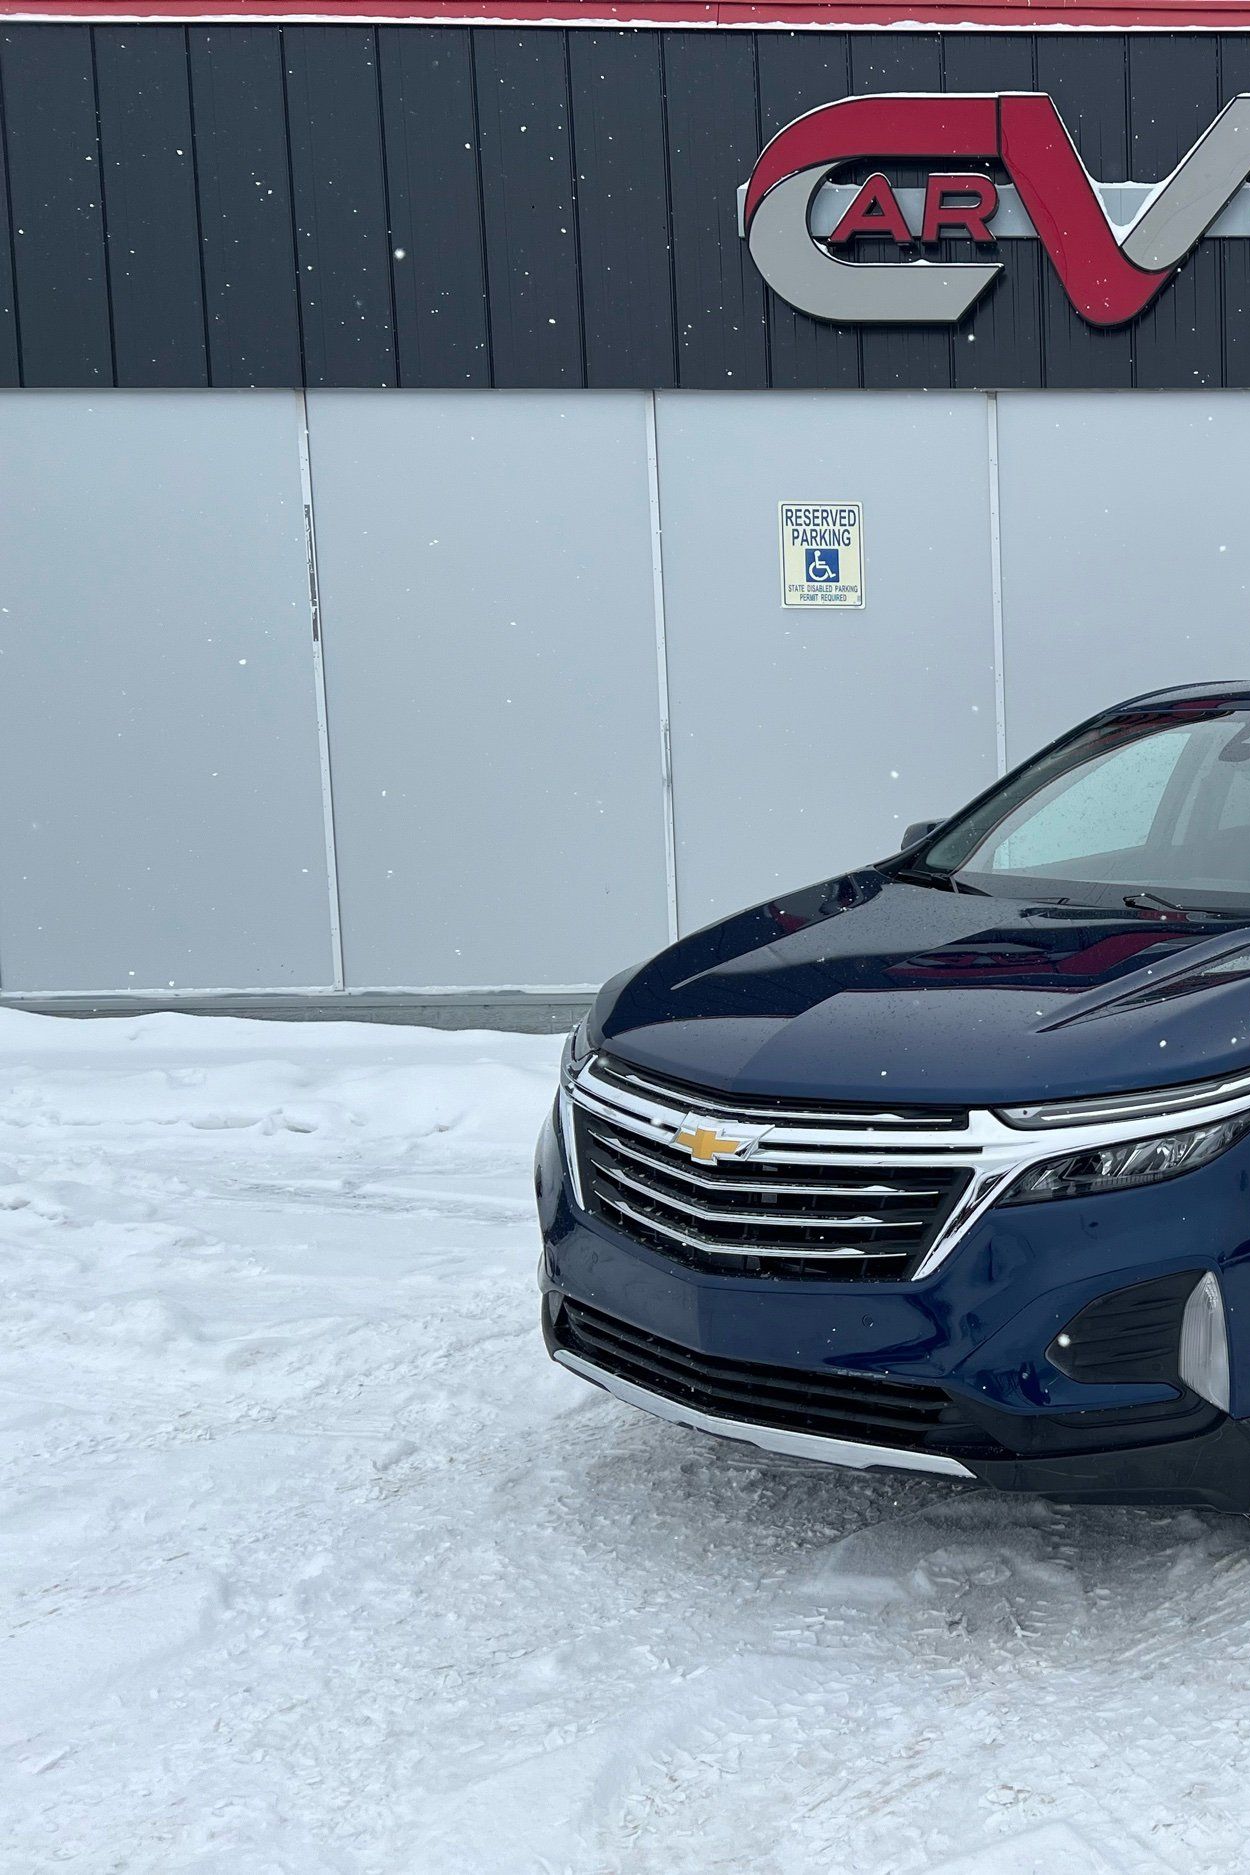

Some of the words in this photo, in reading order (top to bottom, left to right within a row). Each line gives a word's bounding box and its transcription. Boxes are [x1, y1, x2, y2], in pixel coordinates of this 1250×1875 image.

[785, 508, 857, 527] RESERVED
[792, 528, 851, 547] PARKING
[788, 584, 805, 593] STATE
[807, 584, 833, 593] DISABLED
[835, 584, 859, 593] PARKING
[800, 593, 819, 602] PERMIT
[821, 593, 847, 602] REQUIRED
